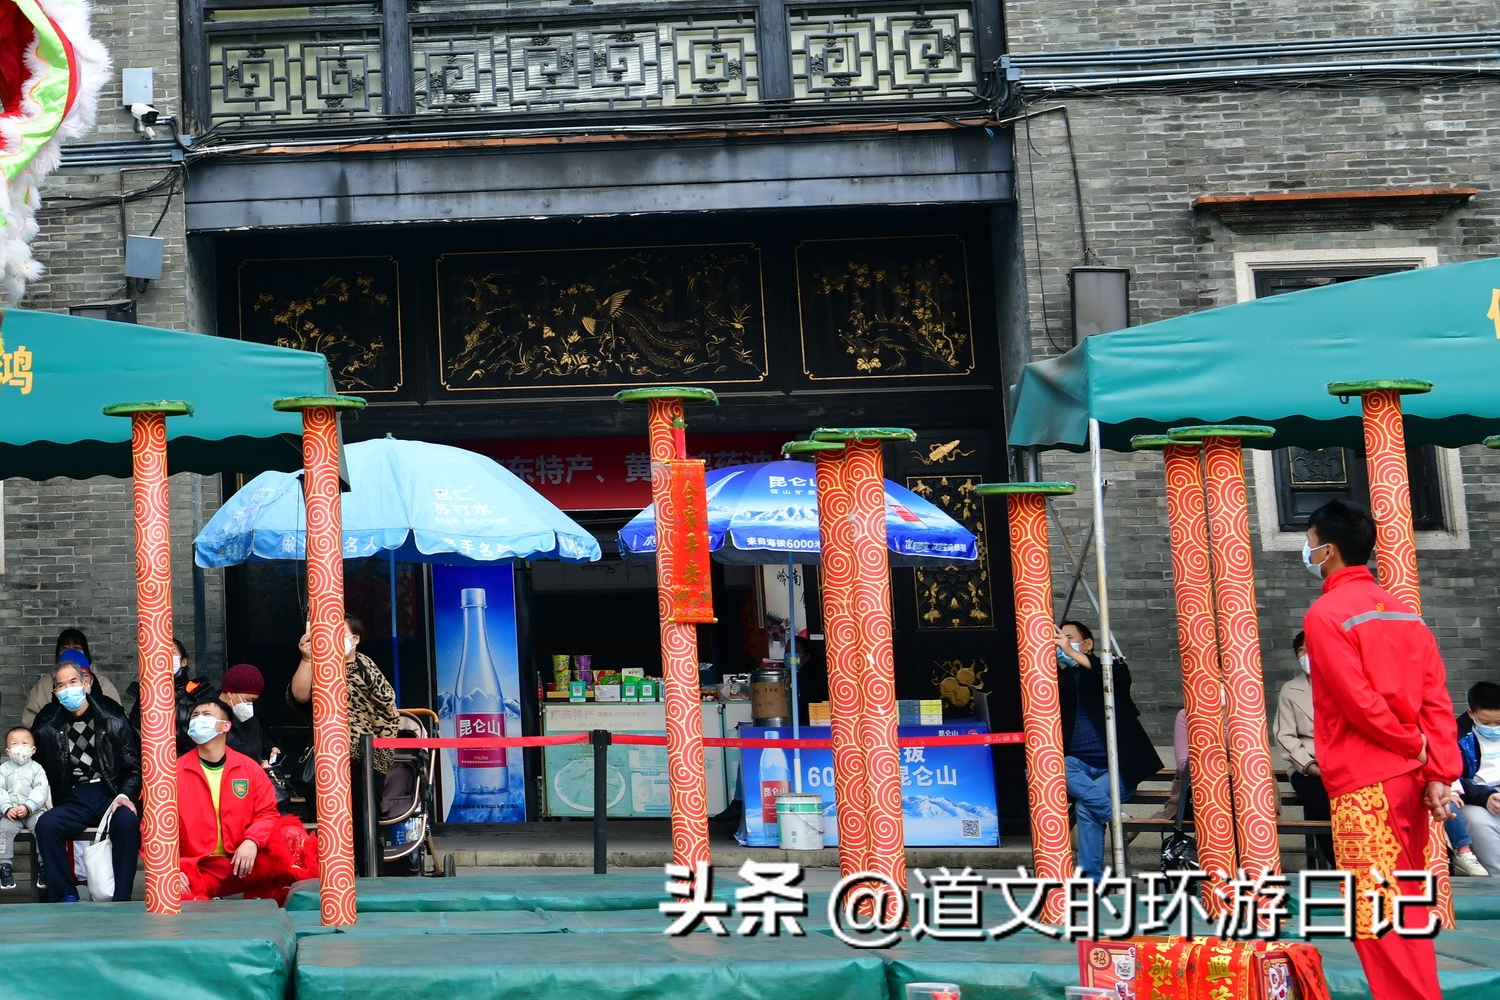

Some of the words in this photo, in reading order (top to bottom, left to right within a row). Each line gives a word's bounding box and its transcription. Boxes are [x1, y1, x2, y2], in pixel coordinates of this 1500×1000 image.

[681, 479, 702, 585] 合家平安
[459, 718, 501, 738] 昆仑山
